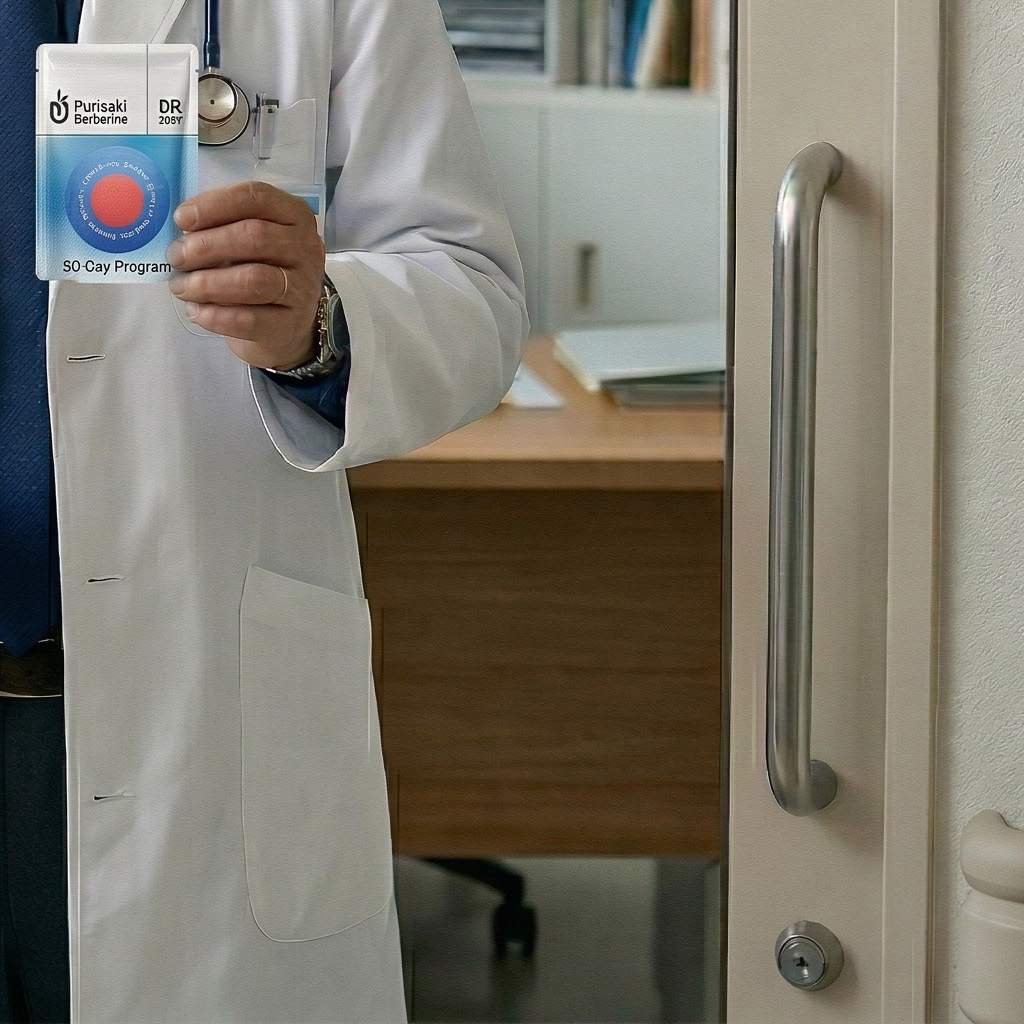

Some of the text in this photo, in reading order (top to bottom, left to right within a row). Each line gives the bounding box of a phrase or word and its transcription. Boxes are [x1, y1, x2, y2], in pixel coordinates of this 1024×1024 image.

[74, 98, 127, 113] Purisaki
[159, 99, 183, 114] DR
[74, 113, 128, 125] Berberine
[114, 260, 172, 276] Program
